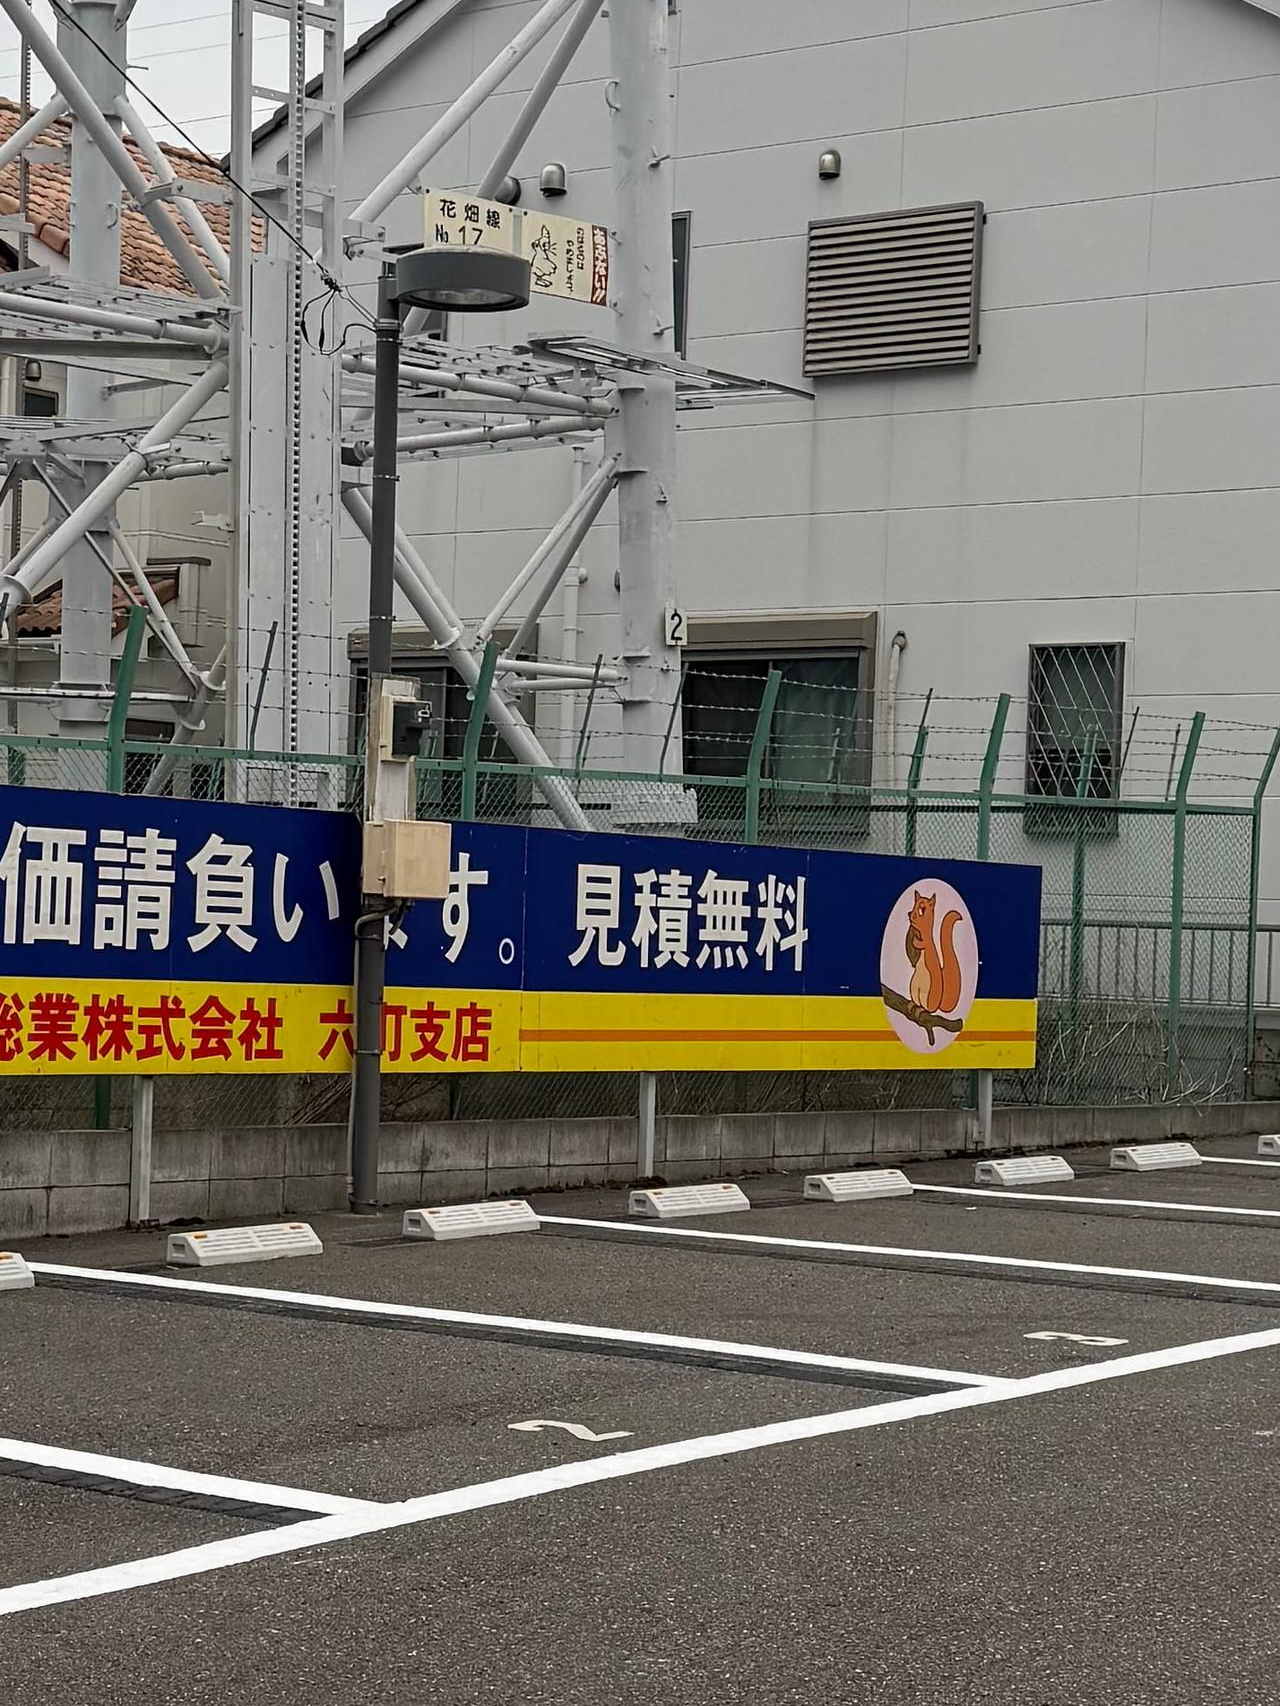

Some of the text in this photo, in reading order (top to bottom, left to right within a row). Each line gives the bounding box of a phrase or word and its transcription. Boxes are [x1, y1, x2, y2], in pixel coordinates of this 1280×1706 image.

[439, 198, 500, 229] 花畑線
[458, 225, 483, 246] 17
[670, 611, 683, 641] 2
[569, 864, 809, 972] 見積無料
[507, 1419, 635, 1442] 2
